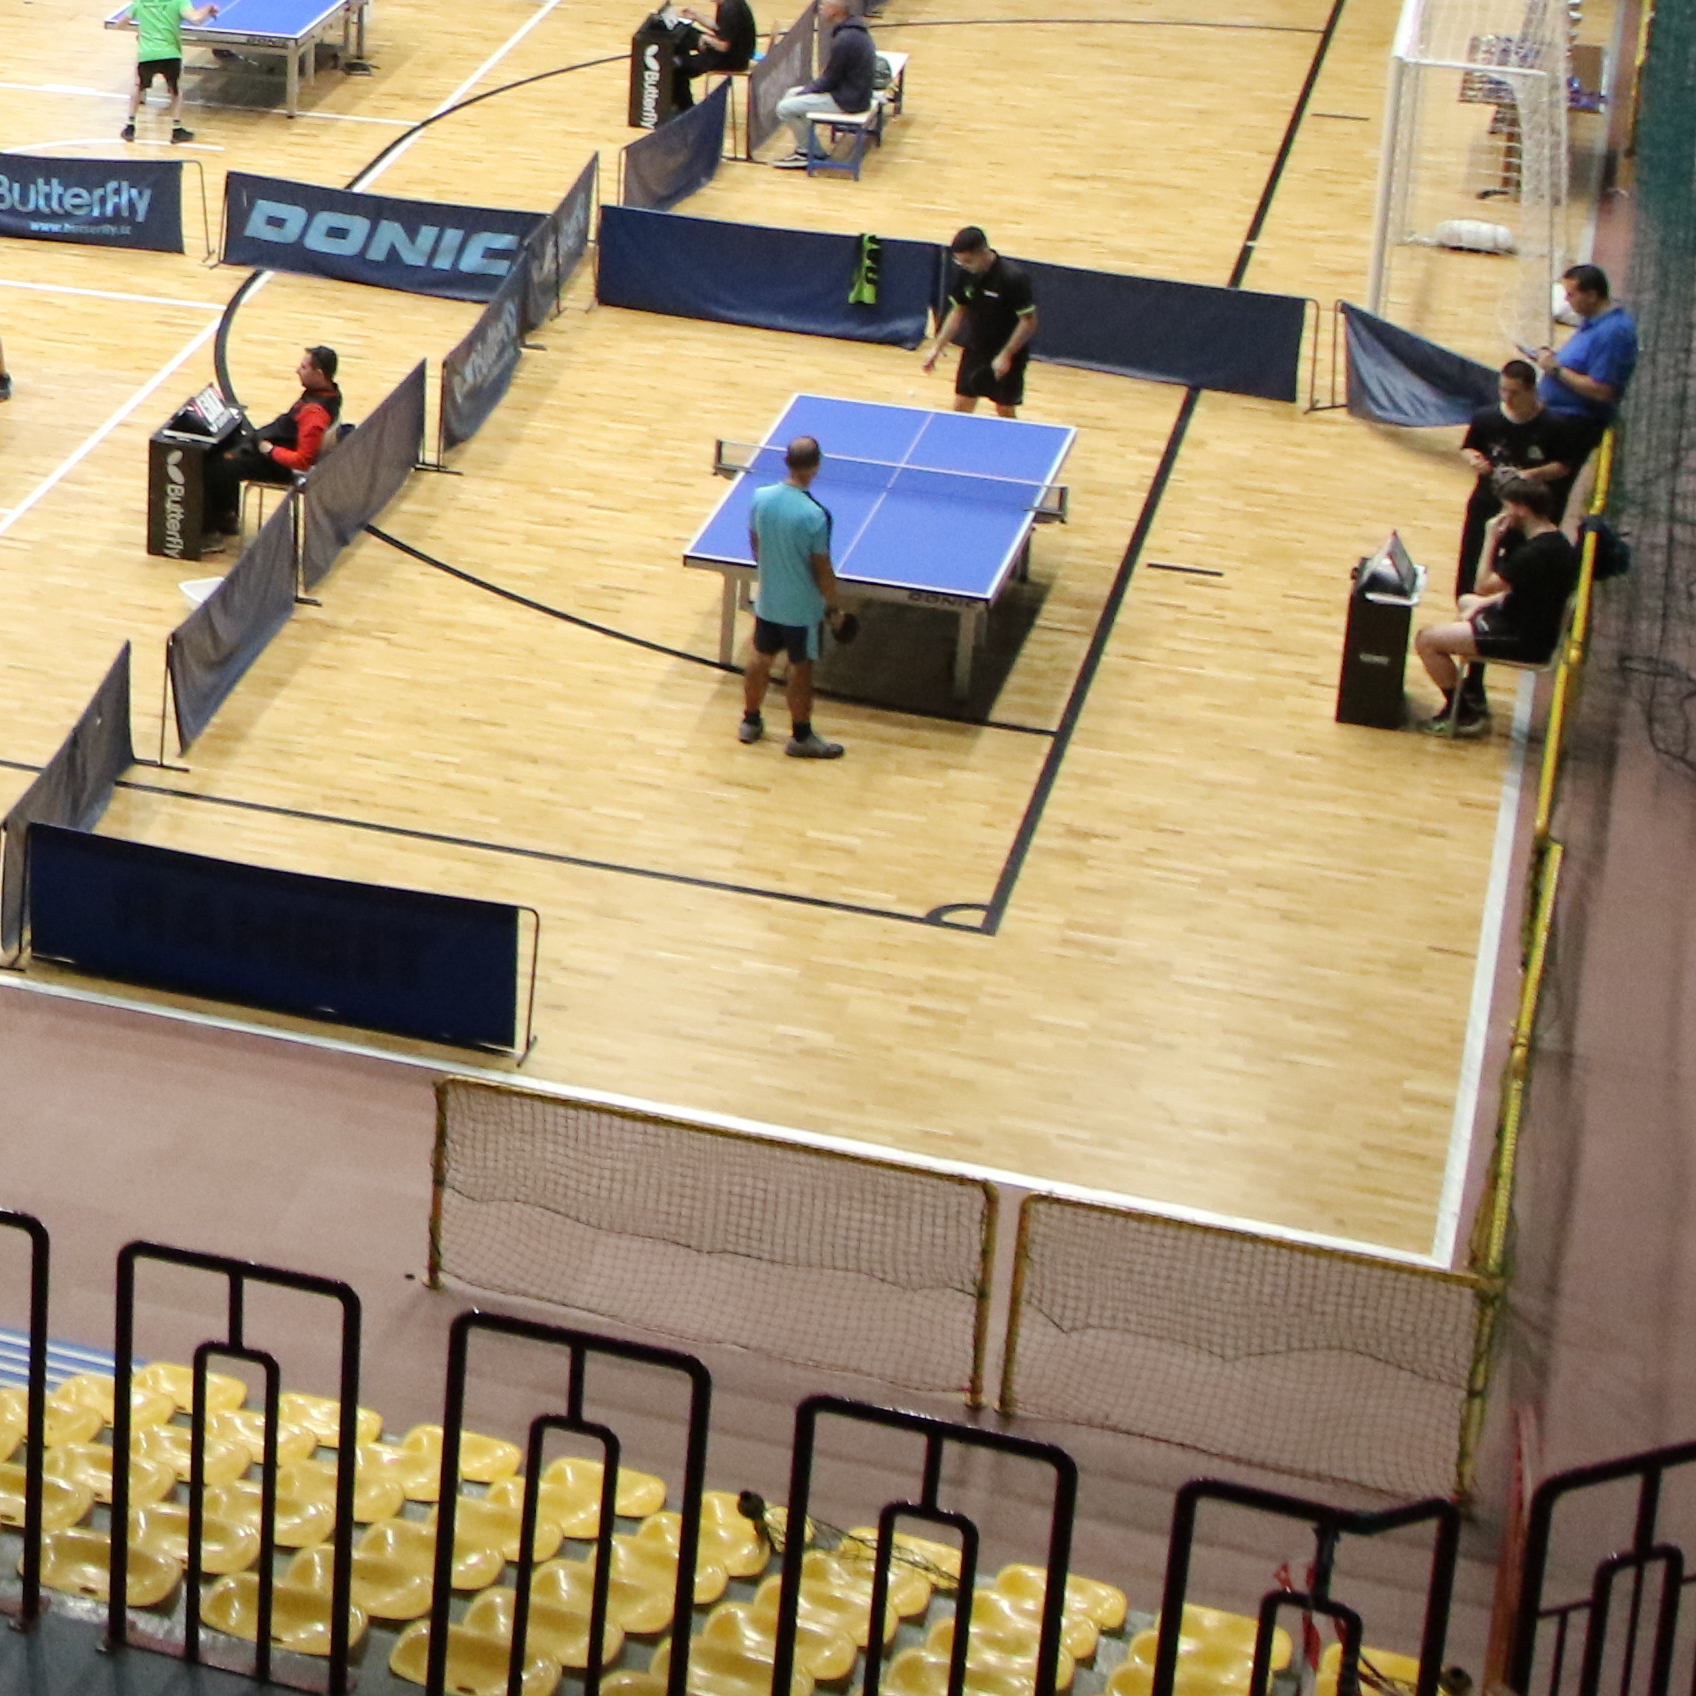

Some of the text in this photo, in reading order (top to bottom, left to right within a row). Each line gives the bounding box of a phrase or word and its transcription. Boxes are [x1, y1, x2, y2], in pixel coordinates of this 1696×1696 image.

[644, 68, 659, 130] Butterfly
[244, 199, 520, 275] DONIC
[163, 484, 186, 559] Butterfly
